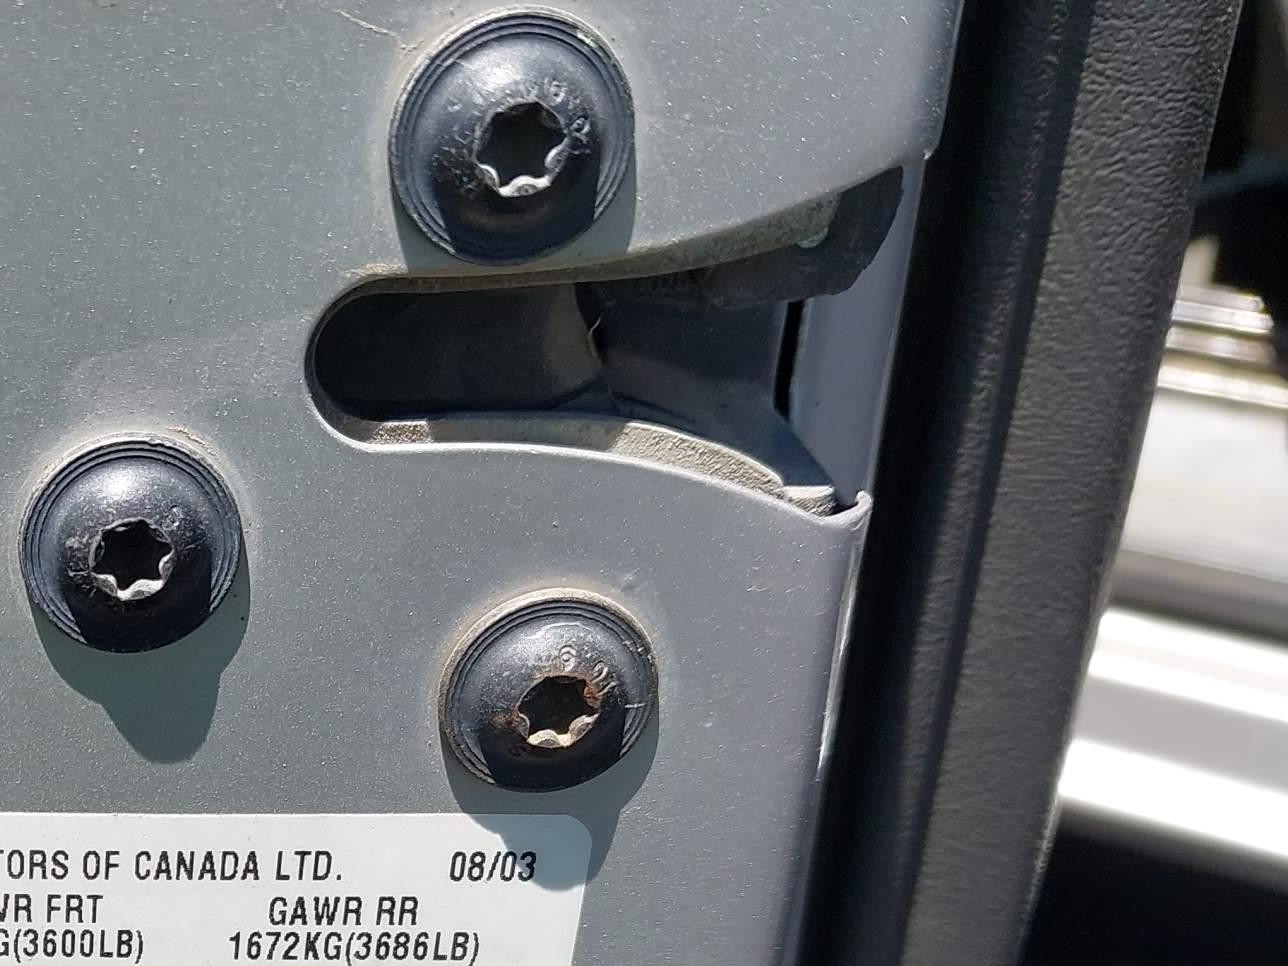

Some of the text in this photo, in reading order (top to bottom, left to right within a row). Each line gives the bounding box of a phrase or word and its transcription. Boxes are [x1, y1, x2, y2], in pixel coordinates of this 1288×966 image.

[82, 850, 120, 880] OF
[135, 850, 260, 881] CANADA
[275, 851, 342, 881] LTD.
[449, 850, 536, 882] 08/03
[47, 895, 103, 923] FRT
[269, 897, 418, 925] GAWR RR
[229, 931, 479, 965] 1672KG(3686LB)
